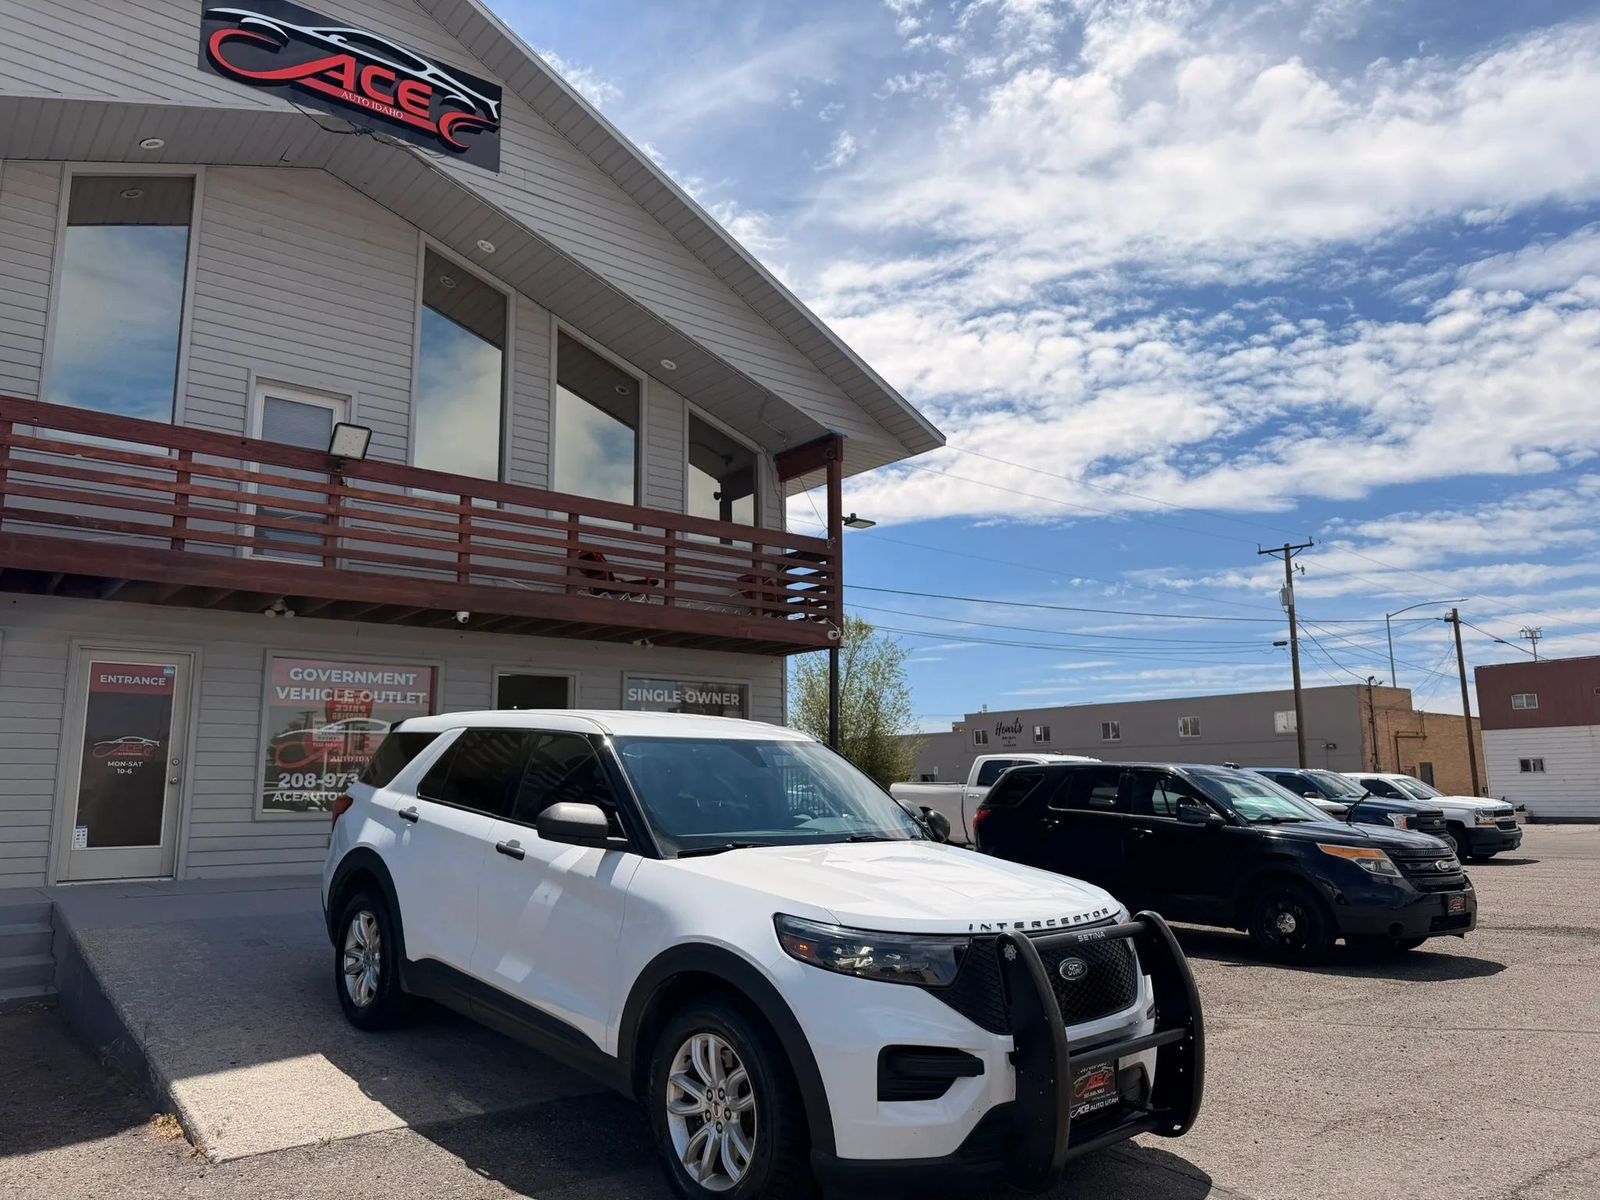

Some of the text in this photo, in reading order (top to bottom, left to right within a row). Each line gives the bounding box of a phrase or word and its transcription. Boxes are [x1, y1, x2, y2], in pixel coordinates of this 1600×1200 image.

[340, 91, 404, 119] AUTO IDAHO
[100, 674, 167, 686] ENTRANCE
[289, 667, 417, 685] GOVERNMENT
[275, 686, 428, 705] VEHICLE OUTLET
[627, 687, 740, 706] SINGLE OWNER
[271, 791, 346, 802] ACEAUTO
[968, 907, 1110, 932] INTERCEPTOR
[1077, 930, 1106, 943] SETINA
[1090, 1101, 1104, 1111] AUTO
[1104, 1097, 1119, 1107] UTAH
